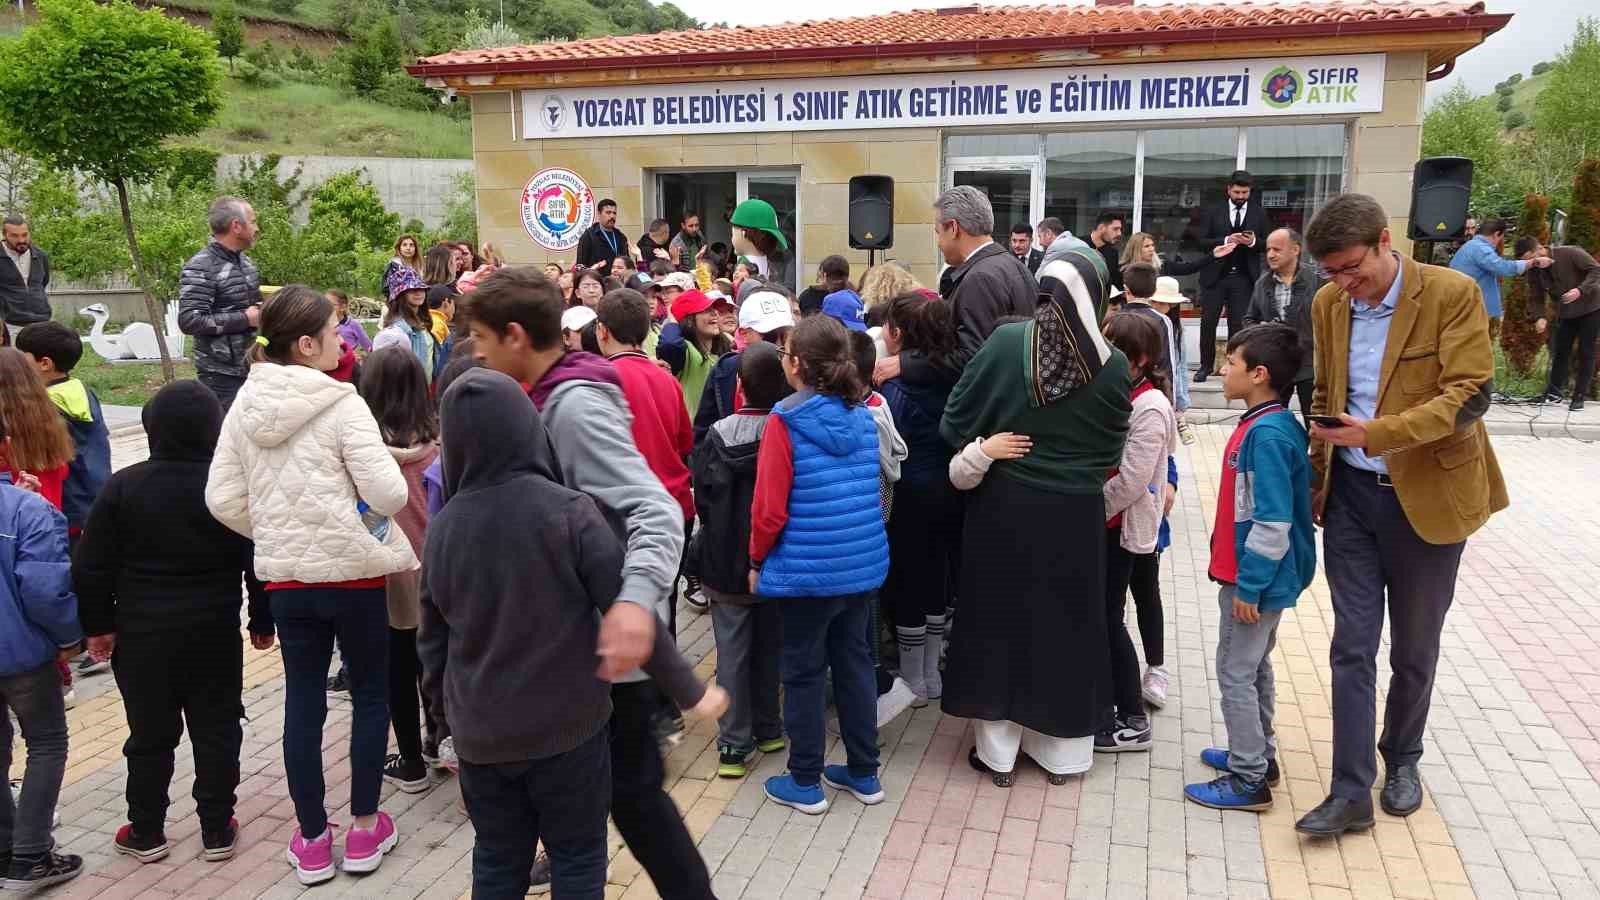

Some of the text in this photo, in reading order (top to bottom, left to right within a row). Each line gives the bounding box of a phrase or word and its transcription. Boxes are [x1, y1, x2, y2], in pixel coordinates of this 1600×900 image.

[1307, 67, 1359, 85] SIFIR
[573, 67, 1249, 128] YOZGAT BELEDİYESİ 1.SINIF ATIK GETİRME ve EĞİTİM MERKEZİ
[1306, 85, 1358, 103] ATIK
[548, 199, 566, 209] SIFIR
[549, 209, 566, 219] ATIK
